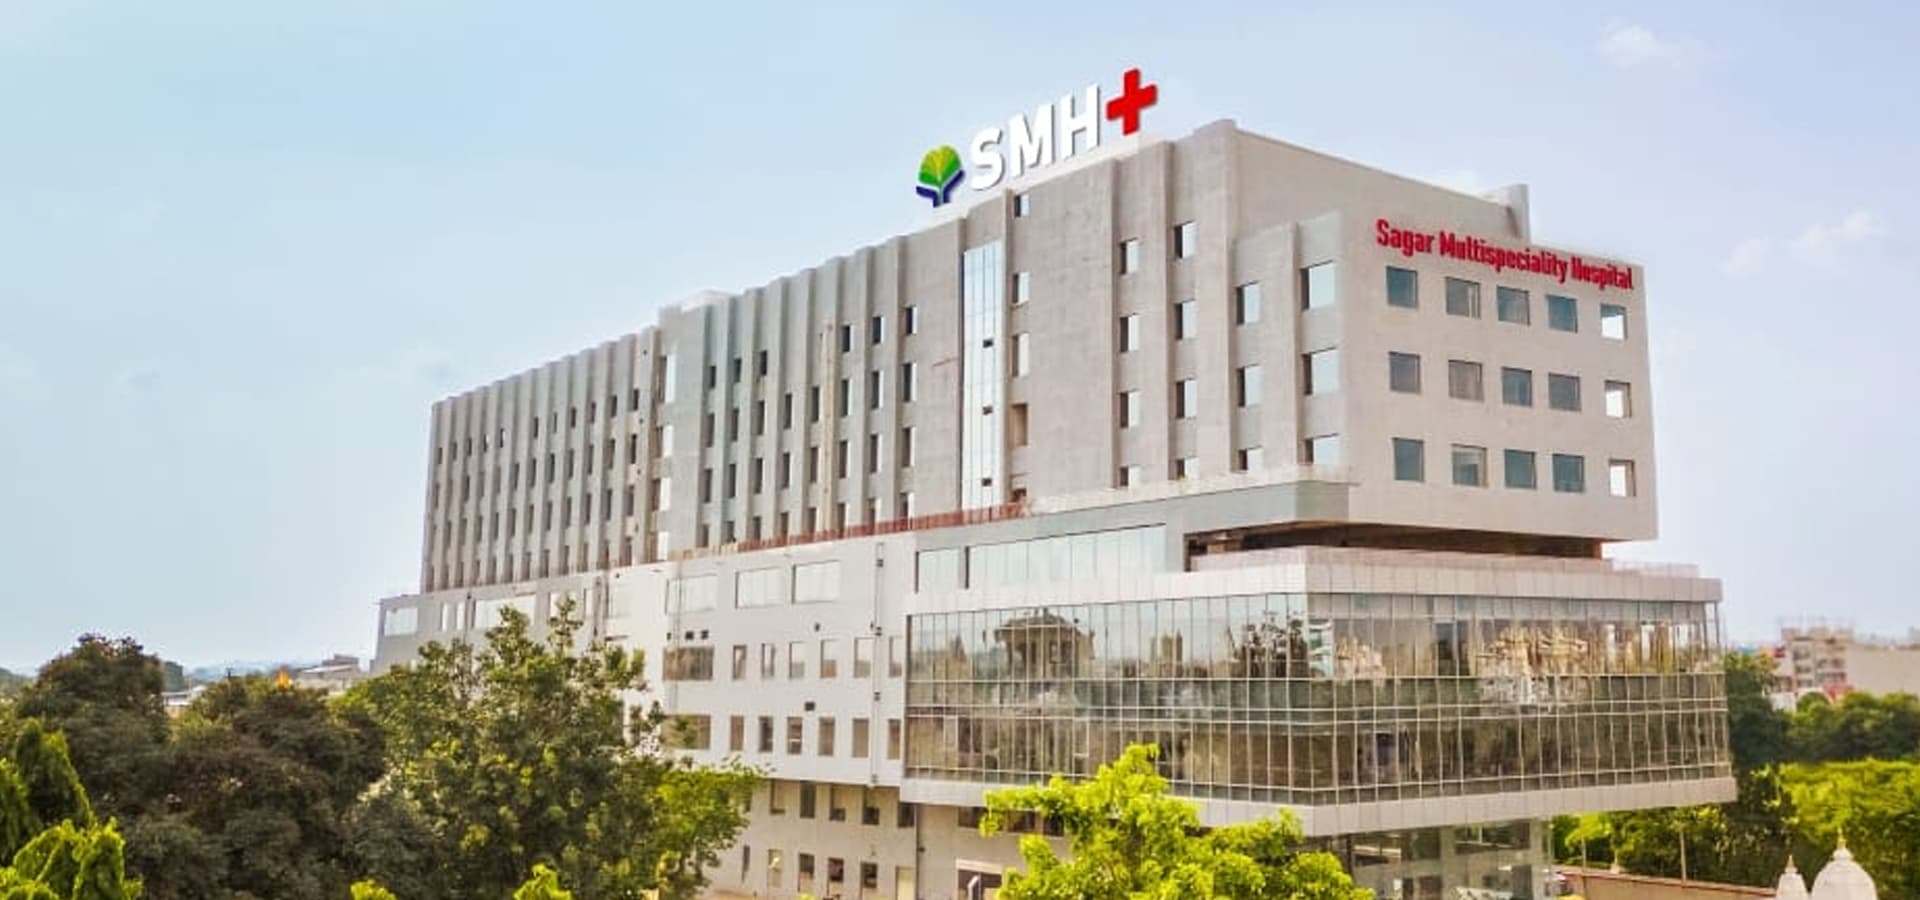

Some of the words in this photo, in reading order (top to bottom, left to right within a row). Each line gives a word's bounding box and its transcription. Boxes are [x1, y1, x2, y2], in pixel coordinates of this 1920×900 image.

[1377, 219, 1435, 257] Sagar
[1439, 231, 1568, 283] Multispeciality
[1571, 256, 1632, 291] Hospital
